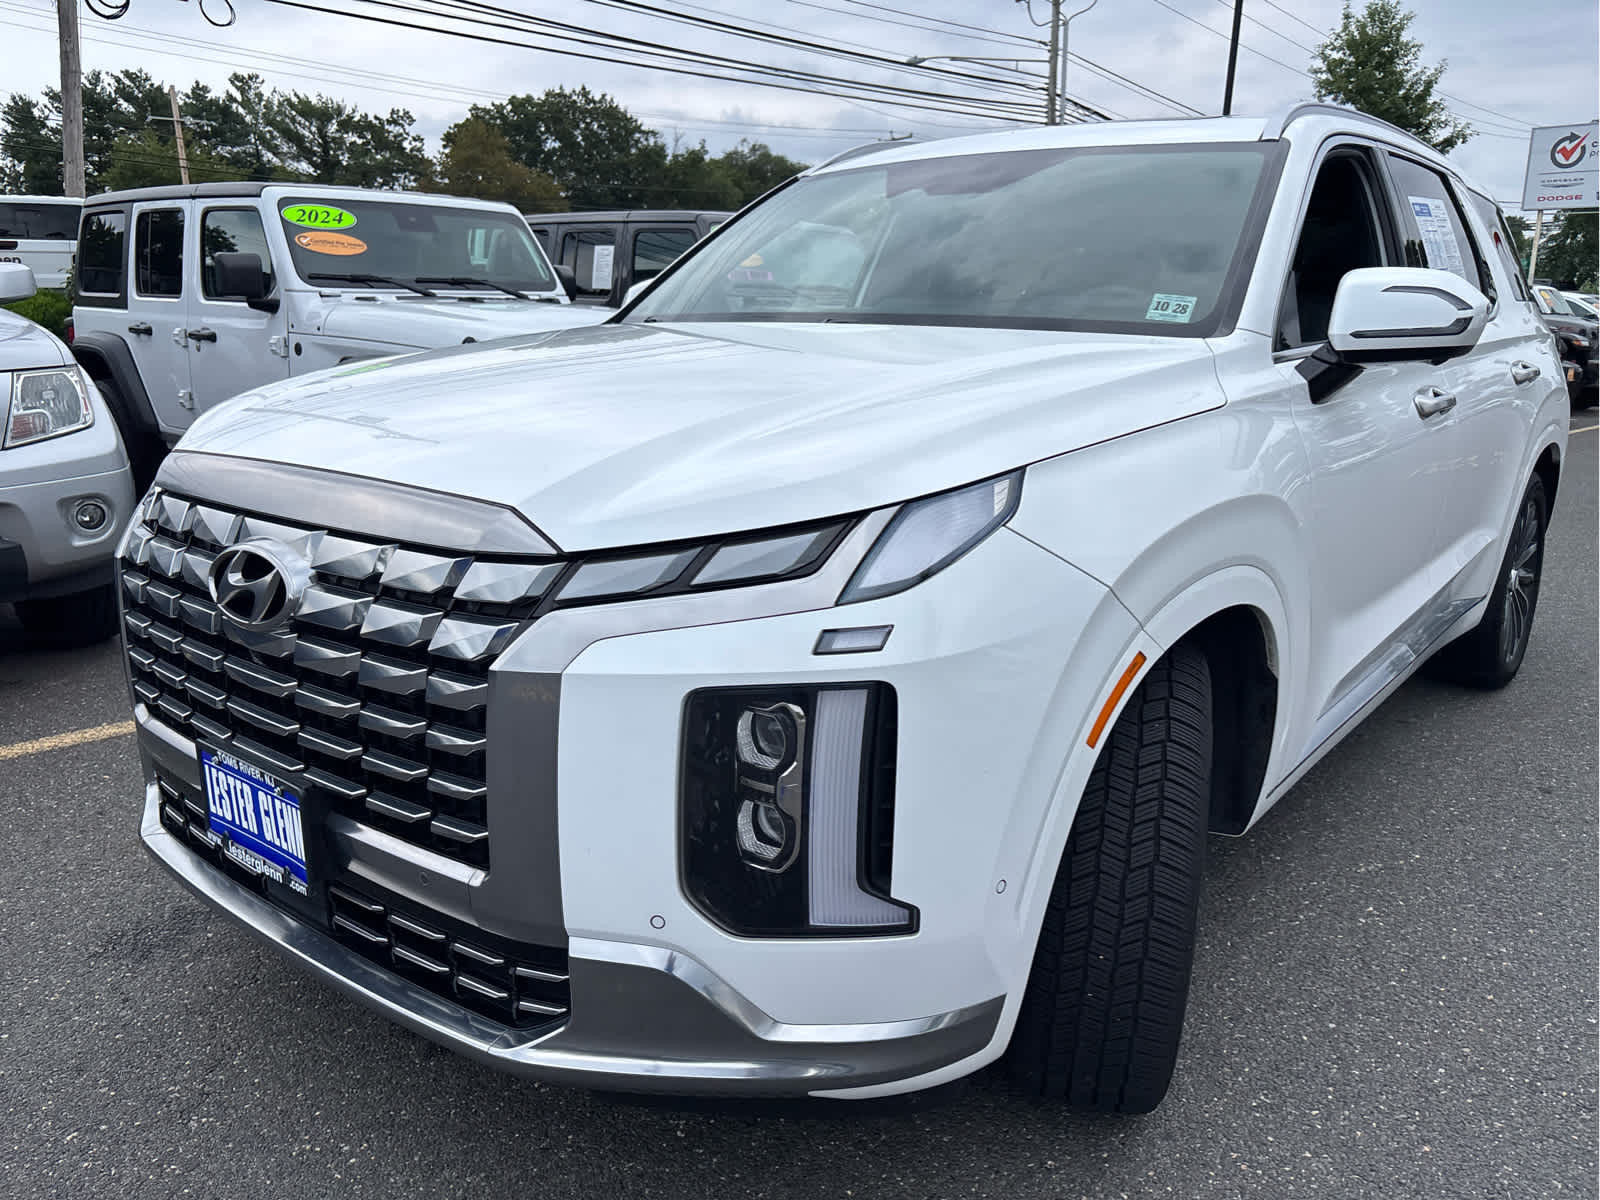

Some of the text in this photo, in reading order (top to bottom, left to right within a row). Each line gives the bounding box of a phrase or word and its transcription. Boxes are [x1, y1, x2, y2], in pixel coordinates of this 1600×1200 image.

[1537, 194, 1584, 202] DODGE
[296, 208, 344, 225] 2024
[1153, 301, 1189, 314] 10 28
[217, 751, 239, 770] TOMS
[264, 774, 274, 787] NJ
[204, 764, 305, 862] LESTER GLENN
[228, 840, 283, 883] lesterglenn
[289, 880, 308, 896] .com
